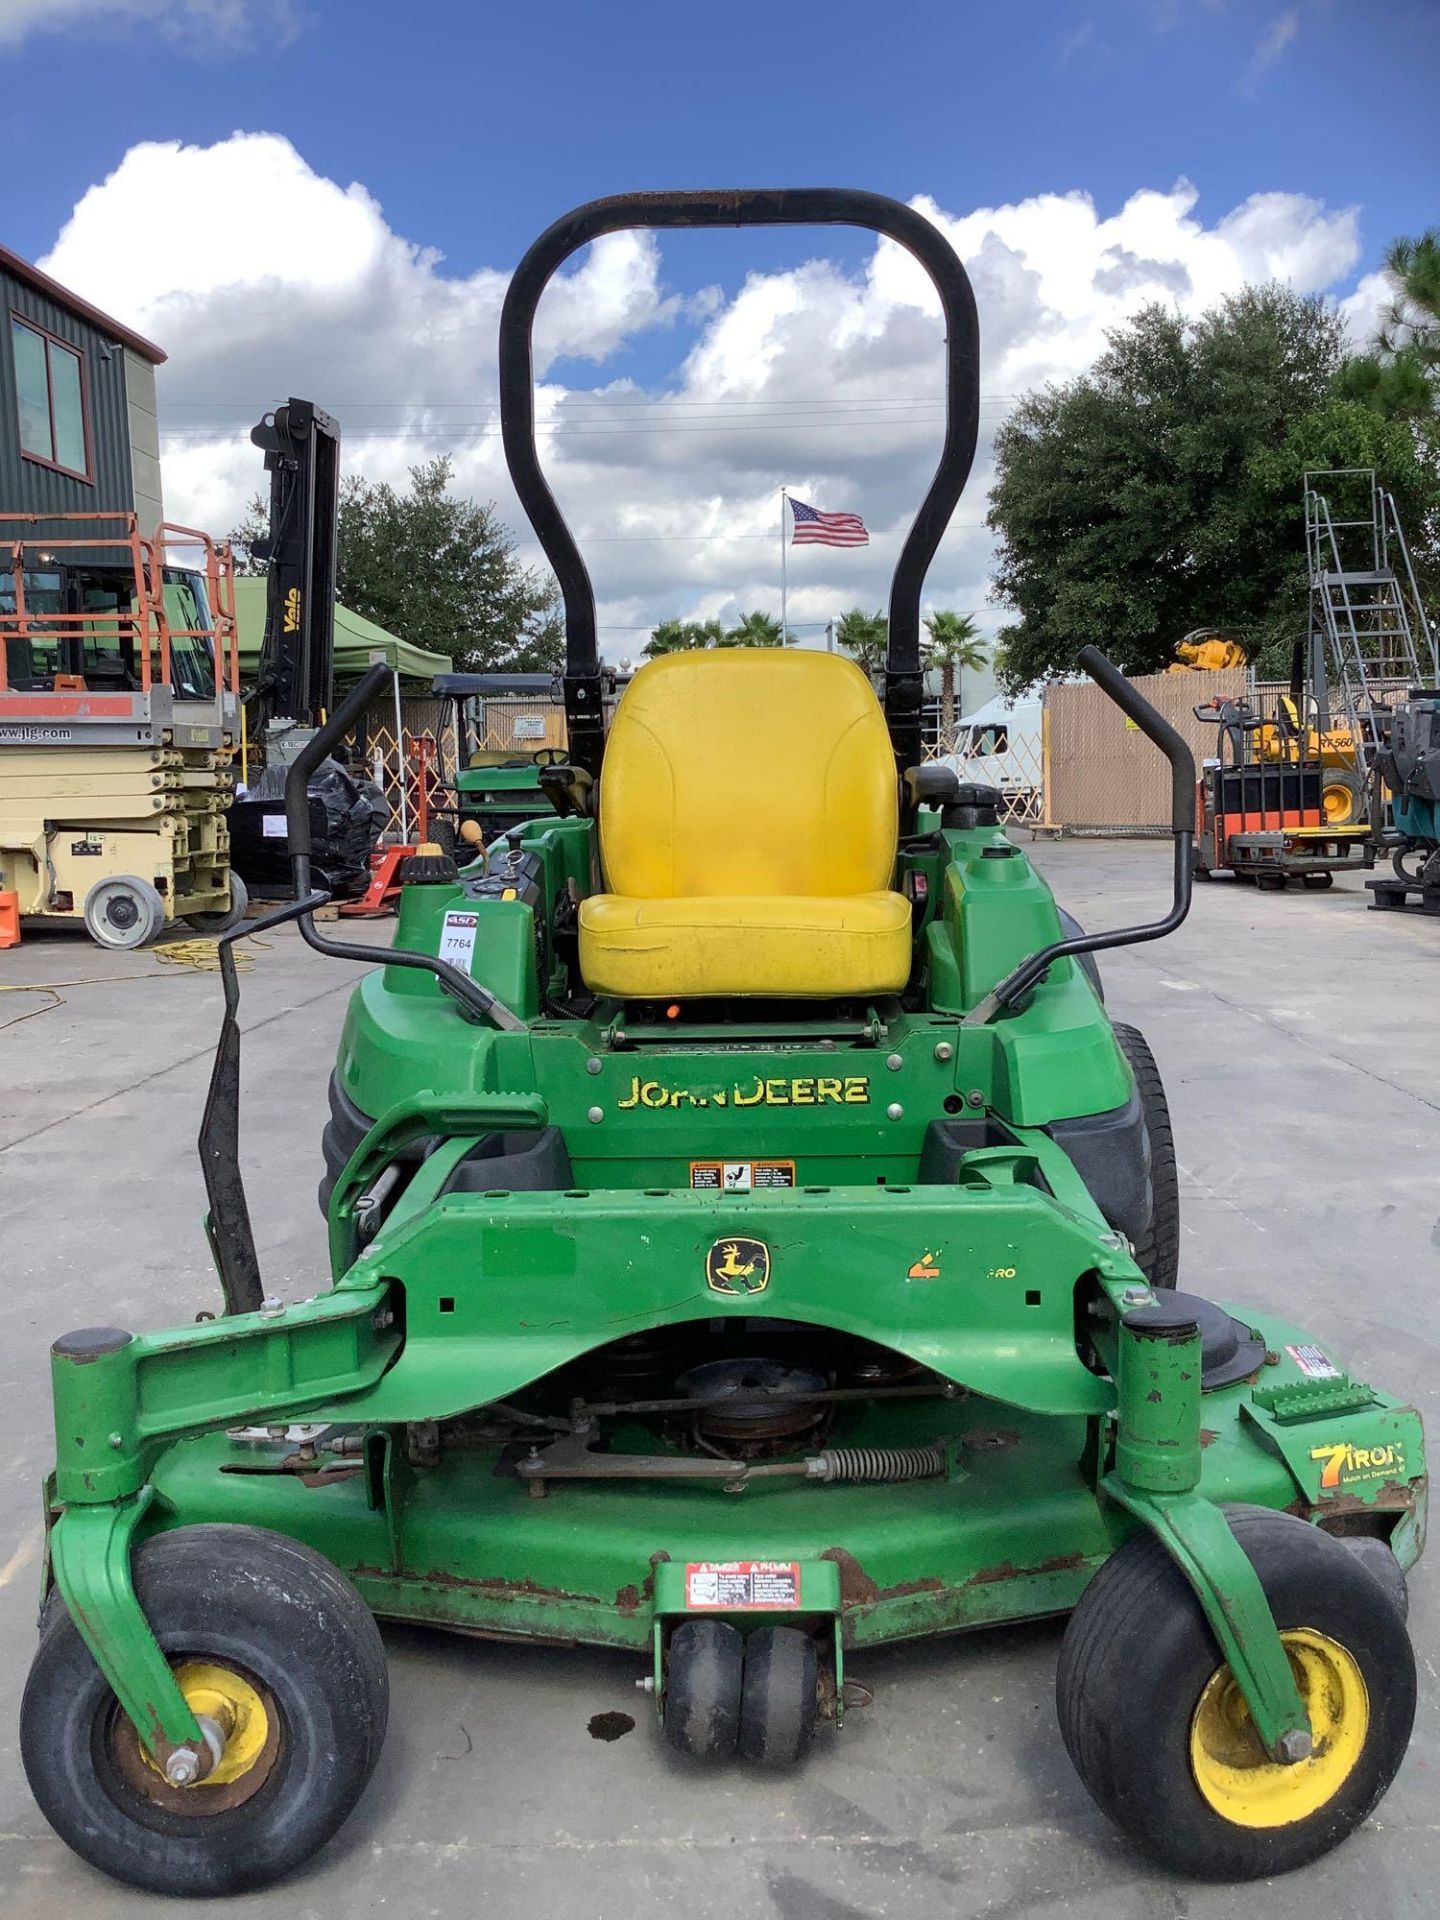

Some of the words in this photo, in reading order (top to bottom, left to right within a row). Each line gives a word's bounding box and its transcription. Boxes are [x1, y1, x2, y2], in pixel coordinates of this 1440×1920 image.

[283, 587, 301, 632] Yale
[447, 938, 472, 949] 7764
[1311, 1443, 1351, 1488] 7
